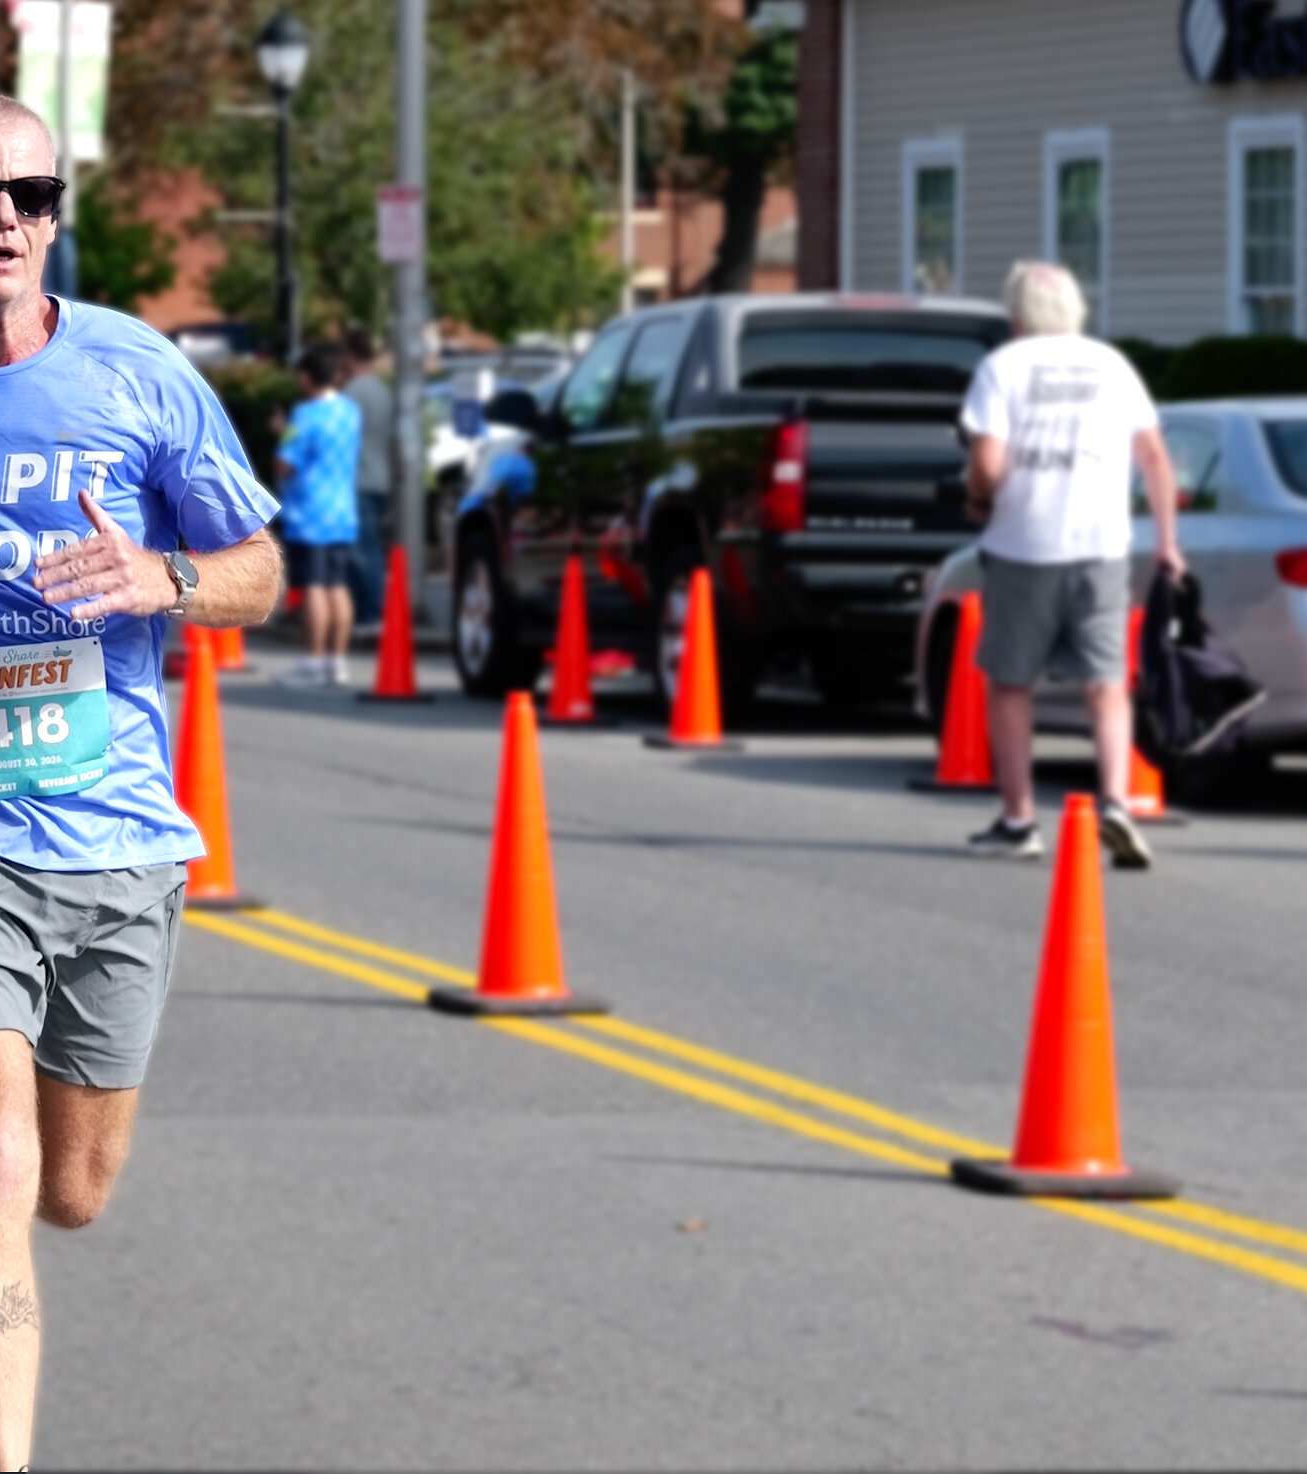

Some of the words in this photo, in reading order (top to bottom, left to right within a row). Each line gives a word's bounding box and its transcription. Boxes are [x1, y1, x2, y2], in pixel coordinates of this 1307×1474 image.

[0, 450, 125, 505] PIT
[3, 648, 40, 664] Shore
[38, 773, 78, 788] BEVERAGE
[80, 768, 104, 781] TICKET
